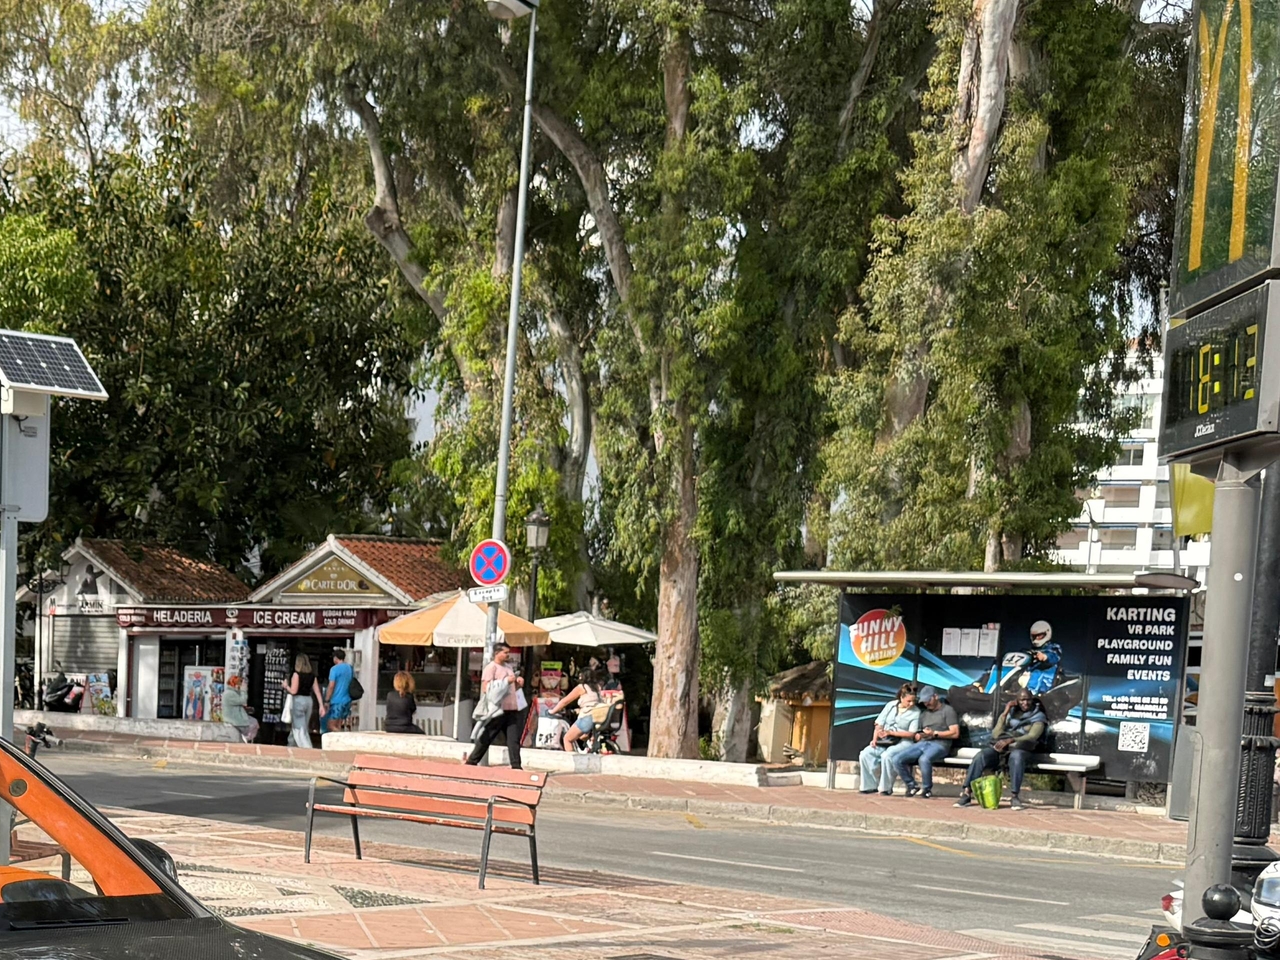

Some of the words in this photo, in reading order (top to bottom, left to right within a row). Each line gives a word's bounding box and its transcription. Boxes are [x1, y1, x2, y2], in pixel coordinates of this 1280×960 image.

[153, 610, 212, 623] HELADERIA
[253, 610, 272, 625] ICE
[274, 610, 316, 625] CREAM
[1106, 607, 1176, 622] KARTING
[849, 616, 903, 643] FUNNY
[1127, 624, 1142, 634] VR
[1144, 624, 1175, 636] PARK
[860, 631, 898, 654] HILL
[1097, 638, 1173, 651] PLAYGROUND
[1106, 653, 1146, 665] FAMILY
[1148, 655, 1172, 666] FUN
[1127, 669, 1171, 681] EVENTS
